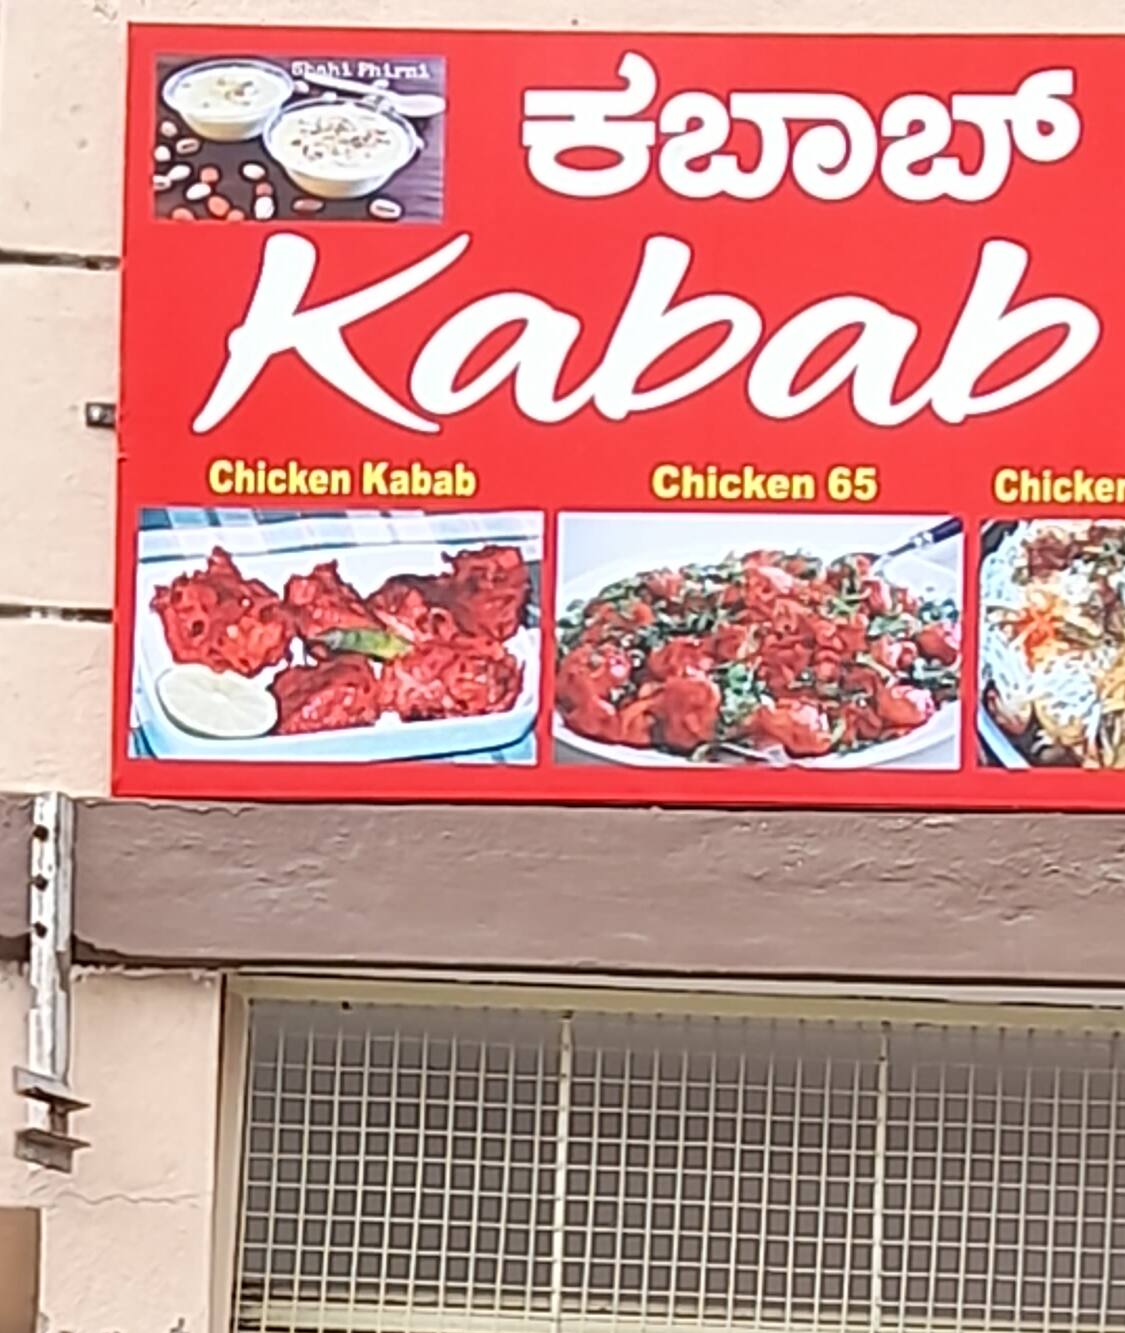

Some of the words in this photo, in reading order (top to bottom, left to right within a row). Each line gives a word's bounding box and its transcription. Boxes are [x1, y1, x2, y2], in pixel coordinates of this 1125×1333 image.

[522, 52, 1080, 201] ಕಬಾಬ್
[193, 233, 1100, 433] Kabab
[209, 459, 351, 495] Chicken
[362, 461, 476, 496] Kabab
[652, 465, 815, 500] Chicken
[828, 466, 877, 501] 65
